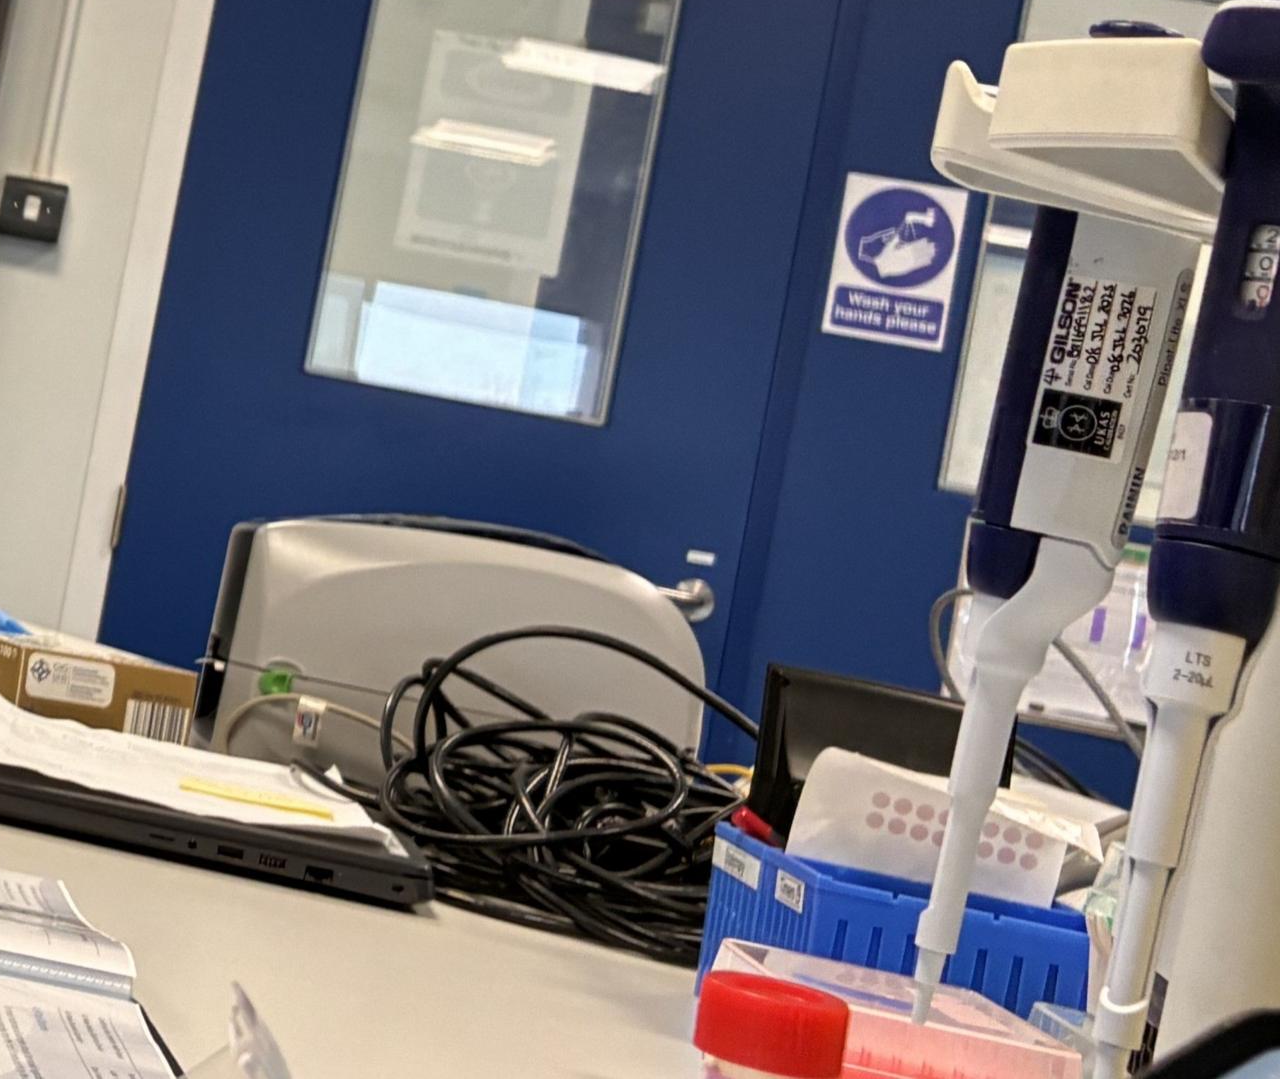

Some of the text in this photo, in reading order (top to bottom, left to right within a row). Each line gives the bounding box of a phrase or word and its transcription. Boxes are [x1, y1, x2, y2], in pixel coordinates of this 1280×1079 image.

[834, 303, 937, 336] hands please
[848, 289, 930, 319] Wash your
[1050, 282, 1081, 364] GILSON
[1093, 410, 1111, 446] UKAS
[1185, 651, 1212, 667] LTS
